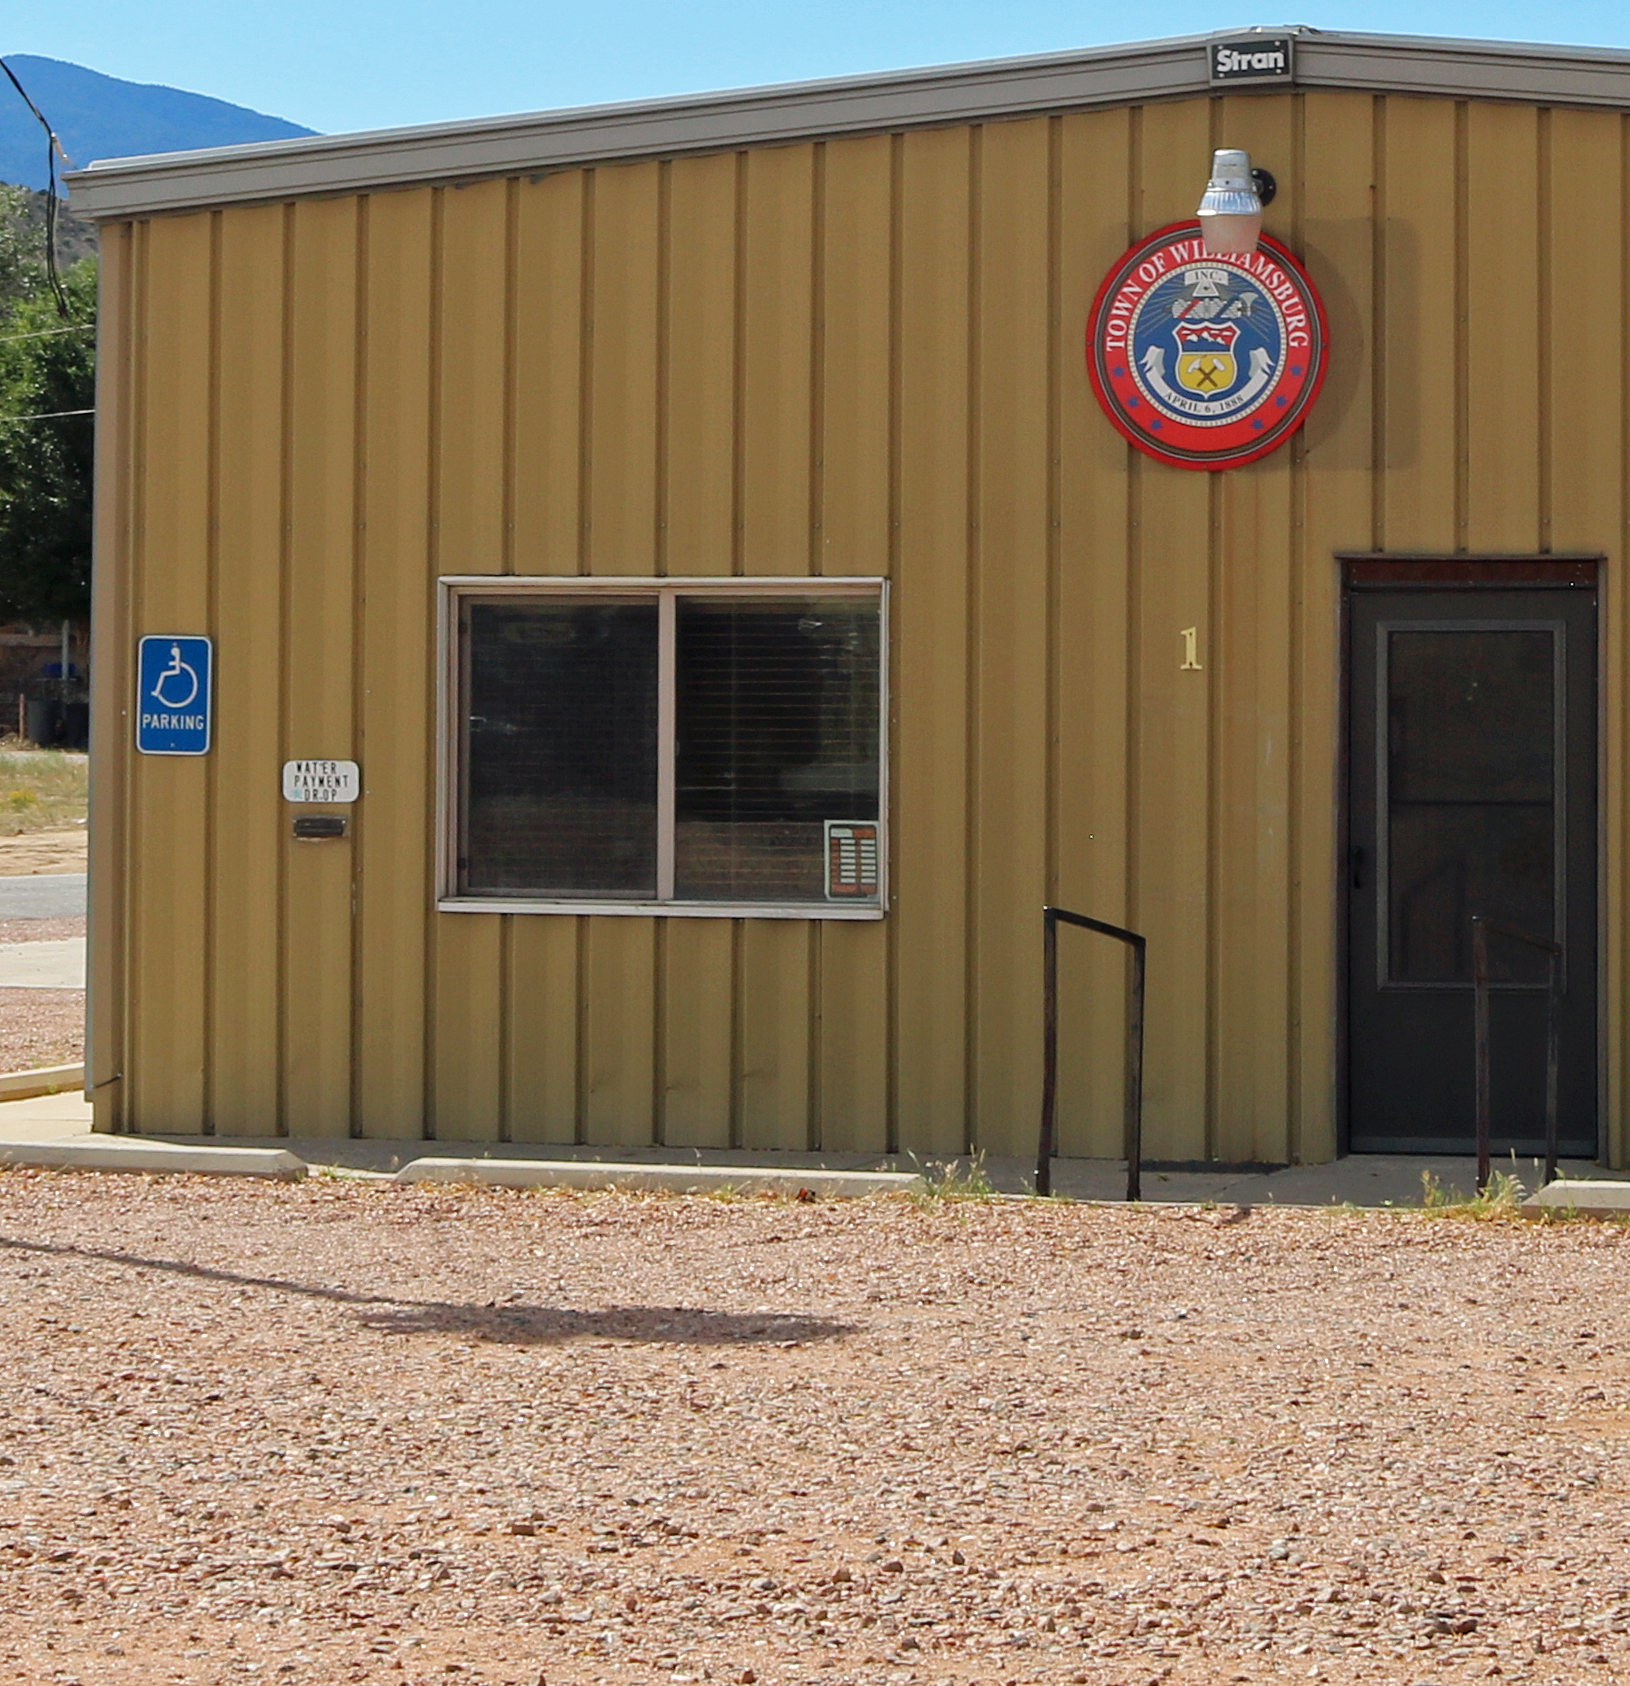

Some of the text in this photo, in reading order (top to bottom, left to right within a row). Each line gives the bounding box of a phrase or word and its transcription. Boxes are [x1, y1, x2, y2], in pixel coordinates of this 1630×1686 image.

[1217, 49, 1284, 72] Stran
[1195, 270, 1222, 281] INC.
[1106, 282, 1144, 351] TOWN
[1138, 252, 1170, 283] OF
[1165, 392, 1245, 414] APRIL 6, 1888
[1180, 626, 1203, 670] 1
[142, 714, 205, 731] PARKING
[296, 762, 337, 774] WATER
[294, 775, 349, 788] PAYMENT
[304, 789, 337, 802] DROP
